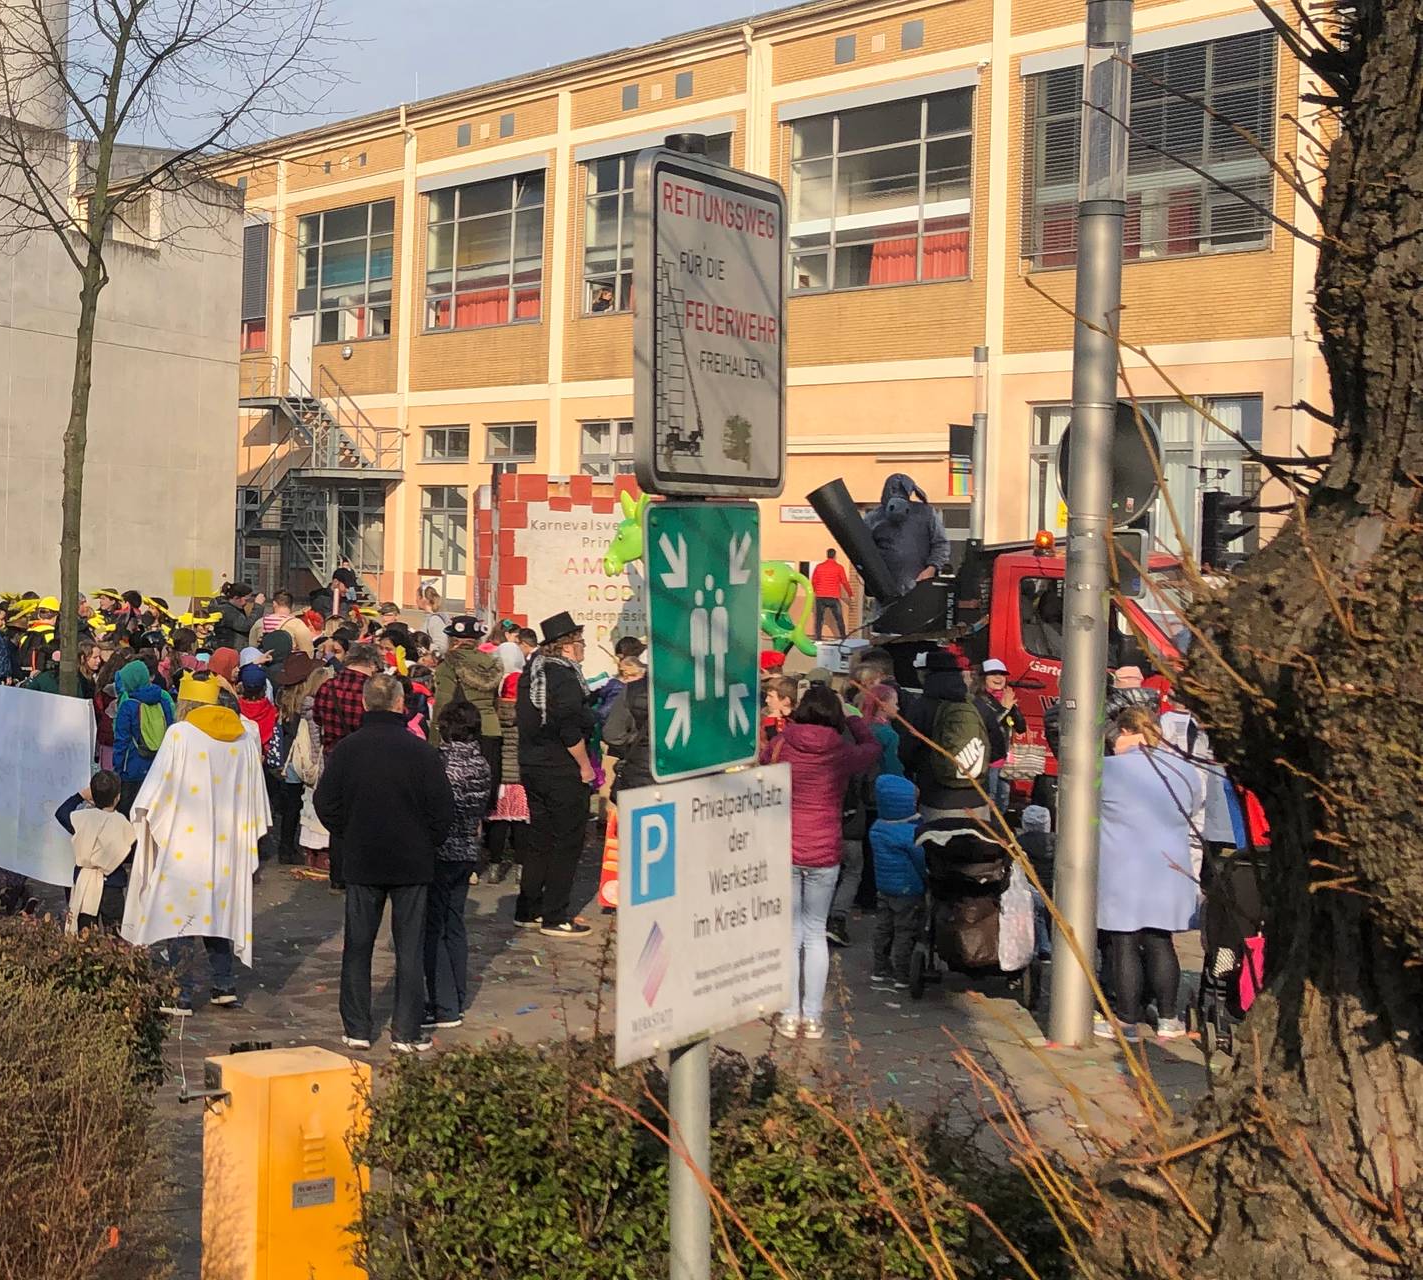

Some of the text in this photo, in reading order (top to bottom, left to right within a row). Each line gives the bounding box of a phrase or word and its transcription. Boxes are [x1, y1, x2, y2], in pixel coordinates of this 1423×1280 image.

[663, 181, 775, 239] RETTUNGSWEG
[680, 249, 725, 280] FÜR DIE
[685, 300, 776, 344] FEUERWEHR
[699, 350, 765, 379] FREIHALTEN
[530, 520, 619, 531] Karnevalsve
[582, 537, 611, 548] Prin
[588, 584, 640, 602] ROBI
[575, 609, 647, 623] inderpräsi
[955, 738, 982, 773] NIKE
[691, 783, 782, 823] Privatparkplatz
[640, 813, 669, 897] P
[728, 827, 749, 852] der
[709, 859, 768, 895] Werkstatt
[693, 895, 782, 939] im Kreis Unna
